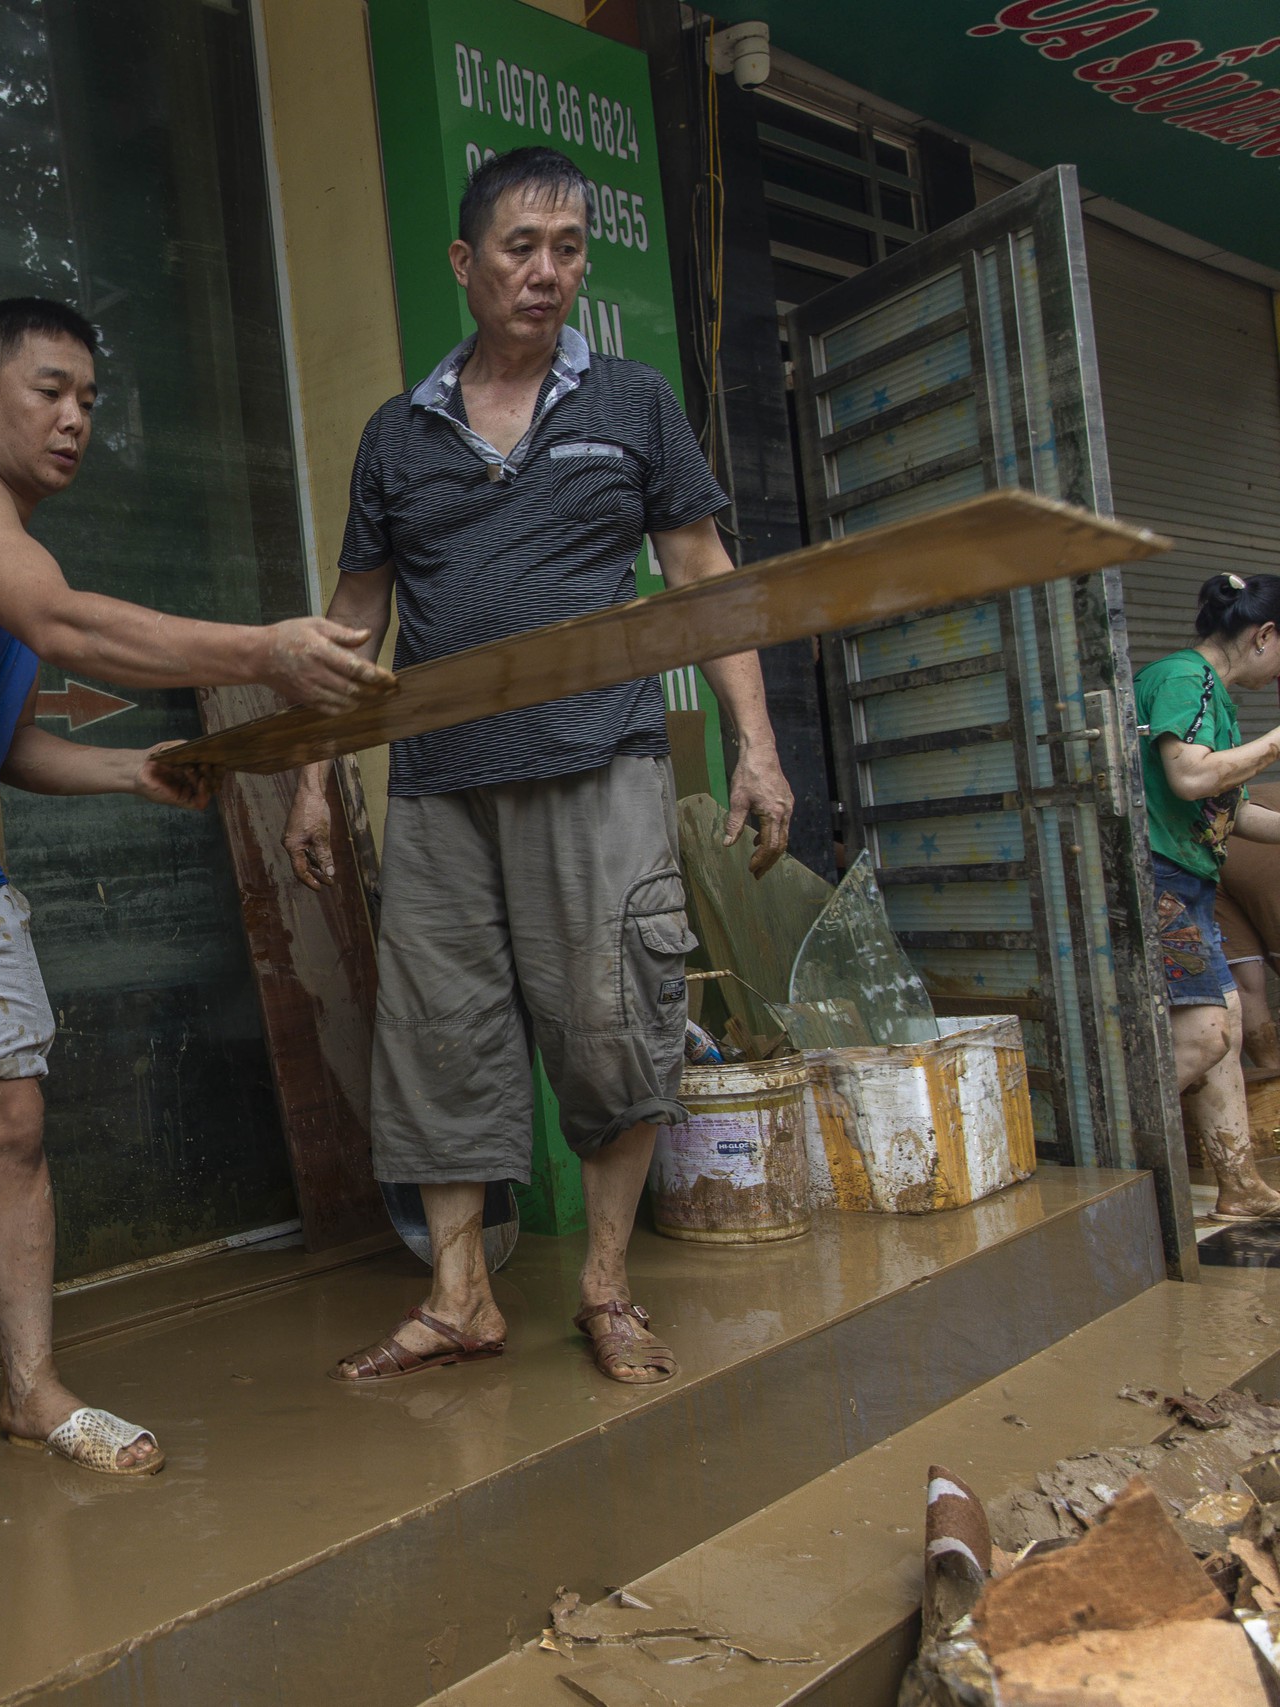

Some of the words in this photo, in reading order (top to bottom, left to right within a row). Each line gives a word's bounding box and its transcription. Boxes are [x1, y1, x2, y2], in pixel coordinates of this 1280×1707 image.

[496, 58, 552, 136] 0978
[556, 81, 585, 146] 86
[588, 92, 640, 164] 6824
